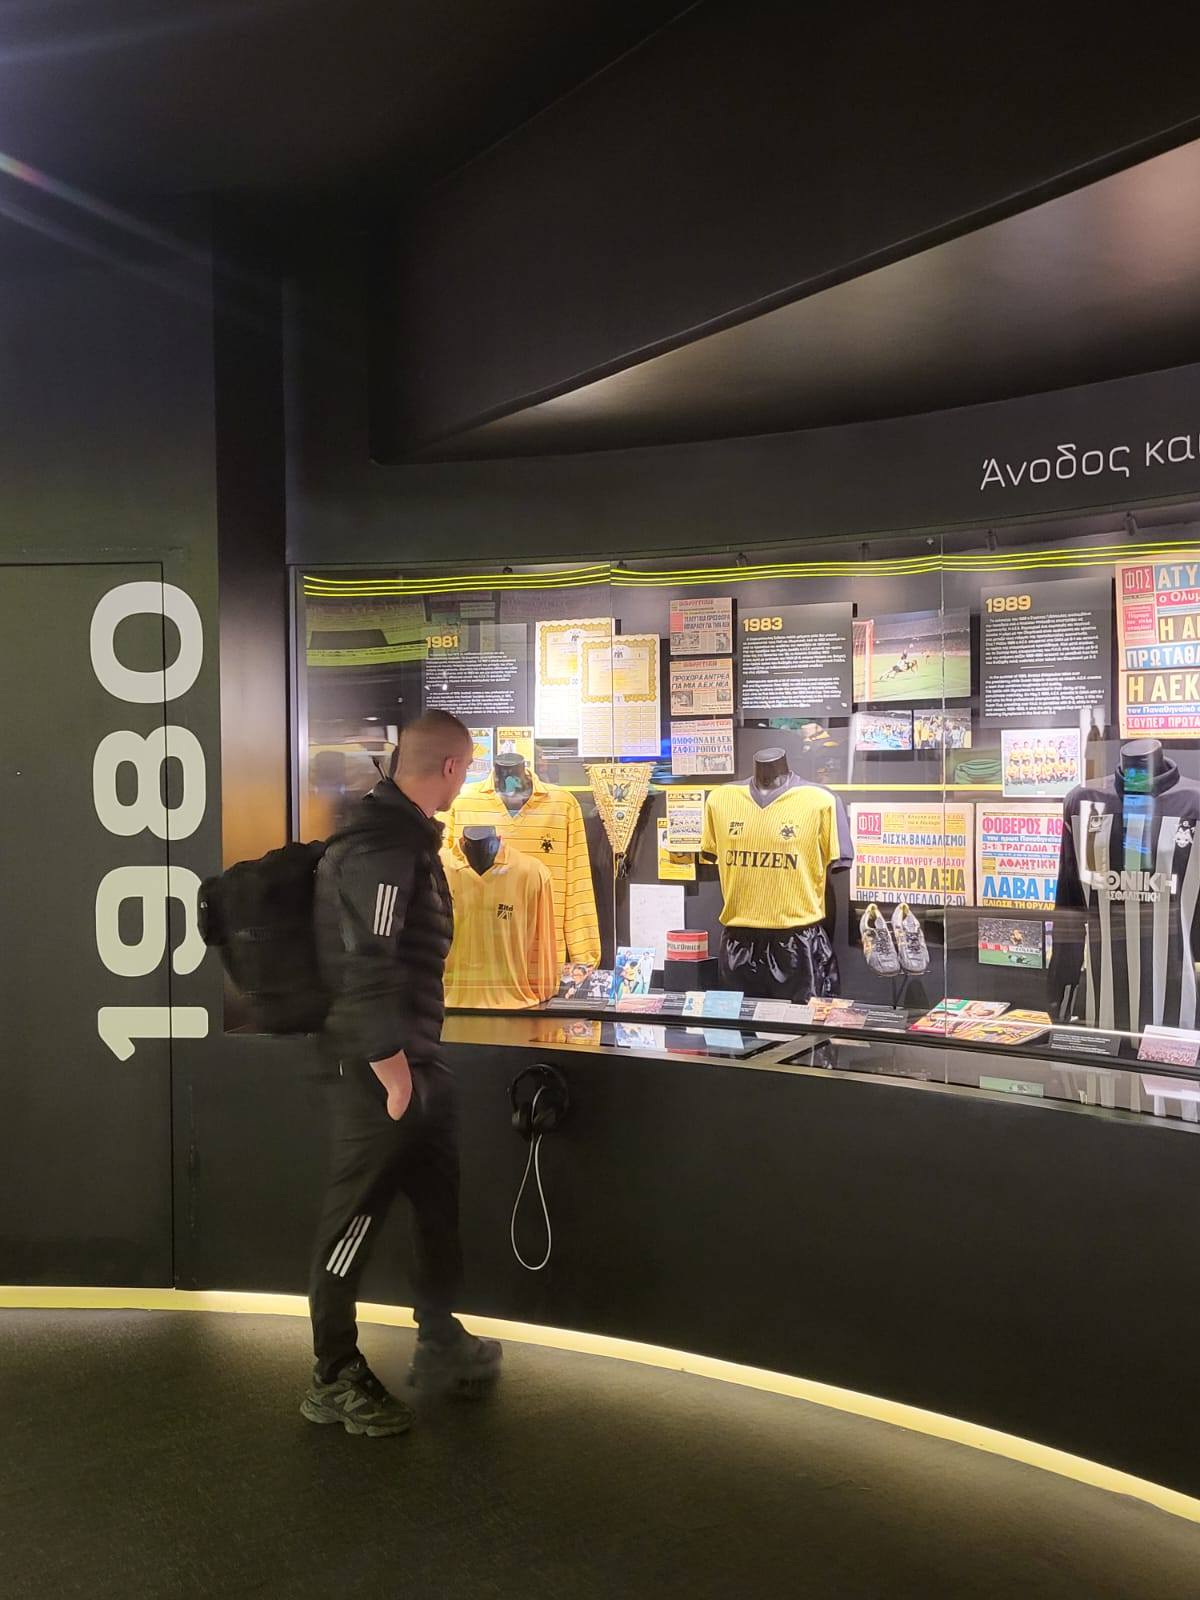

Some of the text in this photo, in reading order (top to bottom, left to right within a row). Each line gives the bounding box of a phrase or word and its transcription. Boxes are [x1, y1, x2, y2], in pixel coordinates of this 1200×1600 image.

[980, 434, 1200, 491] Άνοδος κα
[985, 594, 1032, 613] 1989
[743, 616, 783, 632] 1983
[1182, 615, 1200, 640] Α
[425, 635, 459, 649] 1981
[1128, 675, 1144, 703] Η
[1150, 672, 1200, 703] ΑΕΚ
[1127, 716, 1165, 729] ΣΟΥΠΕΡ
[89, 580, 210, 1062] 1980
[982, 816, 1041, 835] ΦΟΒΕΡΟΣ
[1000, 843, 1048, 853] ΤΡΑΓΩΔΙΑ
[725, 849, 799, 870] CITIZEN
[999, 858, 1056, 870] ΑΘΛΗΤΙΚΗ
[856, 865, 966, 892] Η ΑΕΚΑΡΑ ΑΞΙΑ
[982, 876, 1040, 900] ΛΑΒΑ
